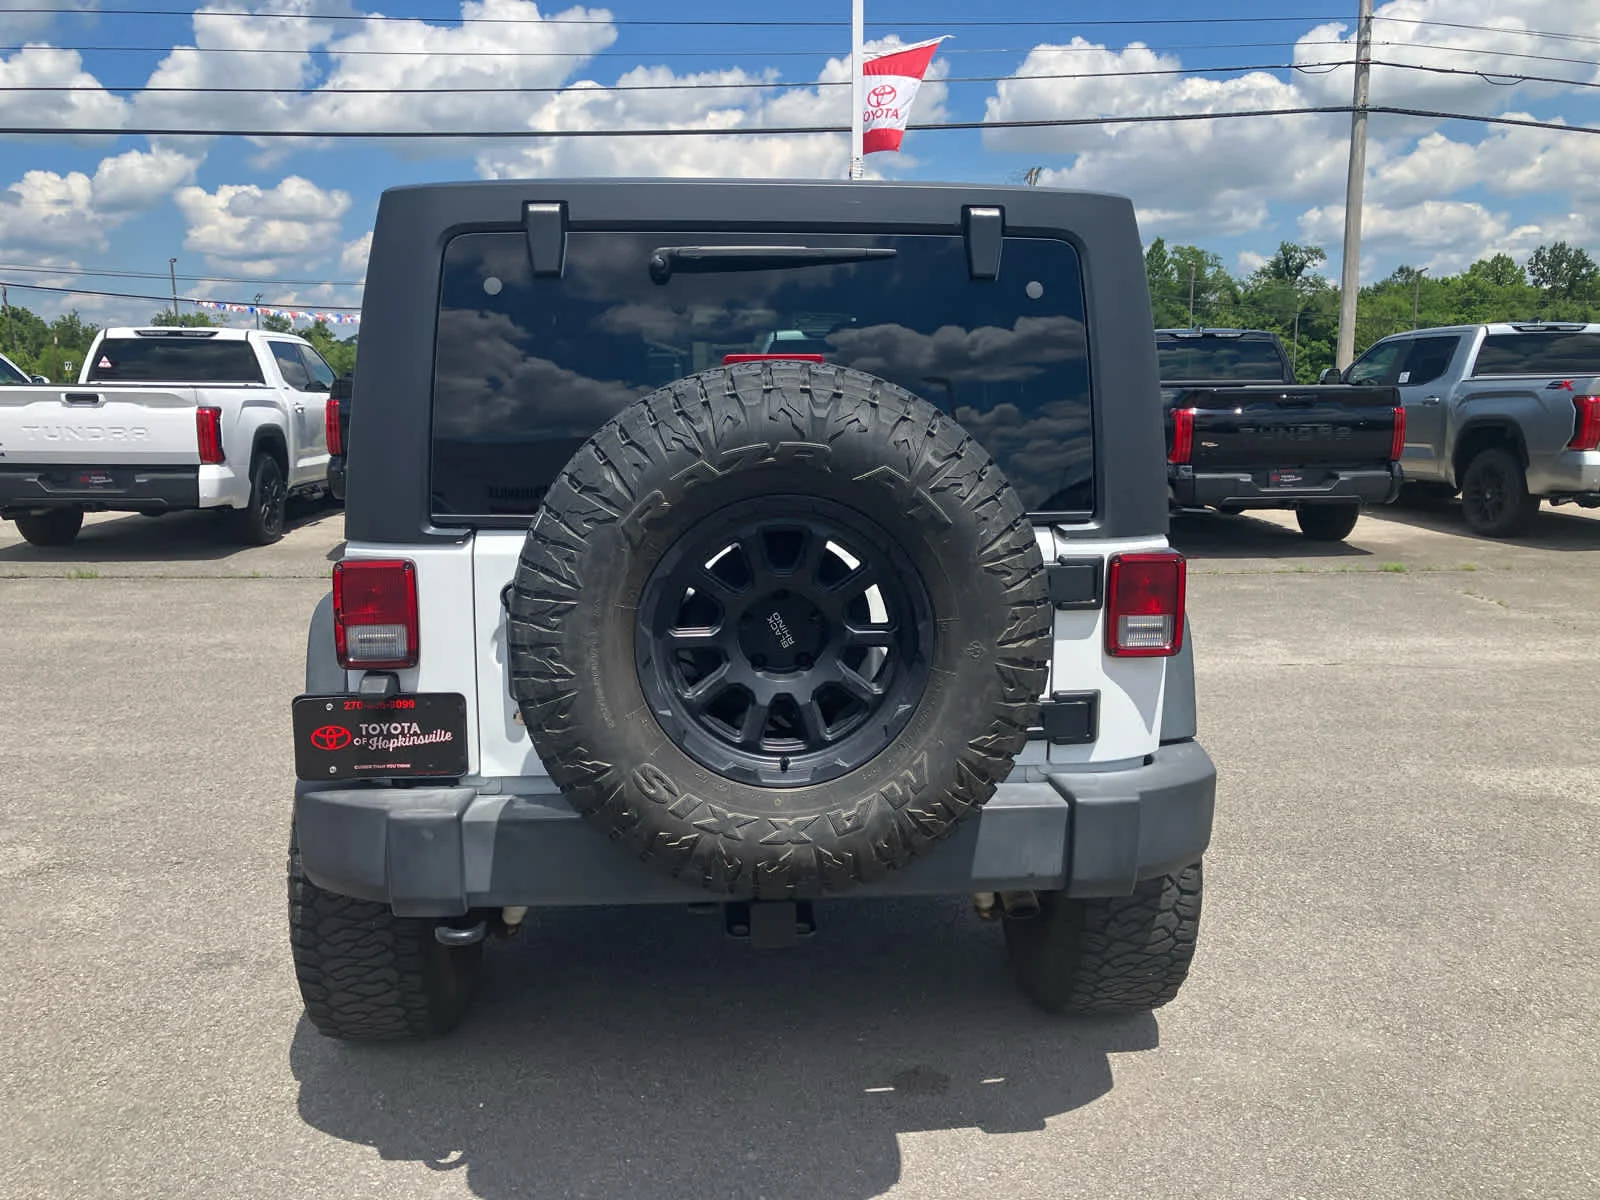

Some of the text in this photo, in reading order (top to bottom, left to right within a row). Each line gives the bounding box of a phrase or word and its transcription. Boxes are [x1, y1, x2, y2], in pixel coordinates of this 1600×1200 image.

[863, 109, 899, 122] OYOTA
[21, 425, 151, 442] TUNDRA
[767, 616, 789, 648] BLACK
[772, 612, 795, 644] RHINO
[360, 722, 421, 735] TOYOTA
[353, 729, 453, 751] OF Hopkinsville
[633, 751, 928, 845] MAXXIS
